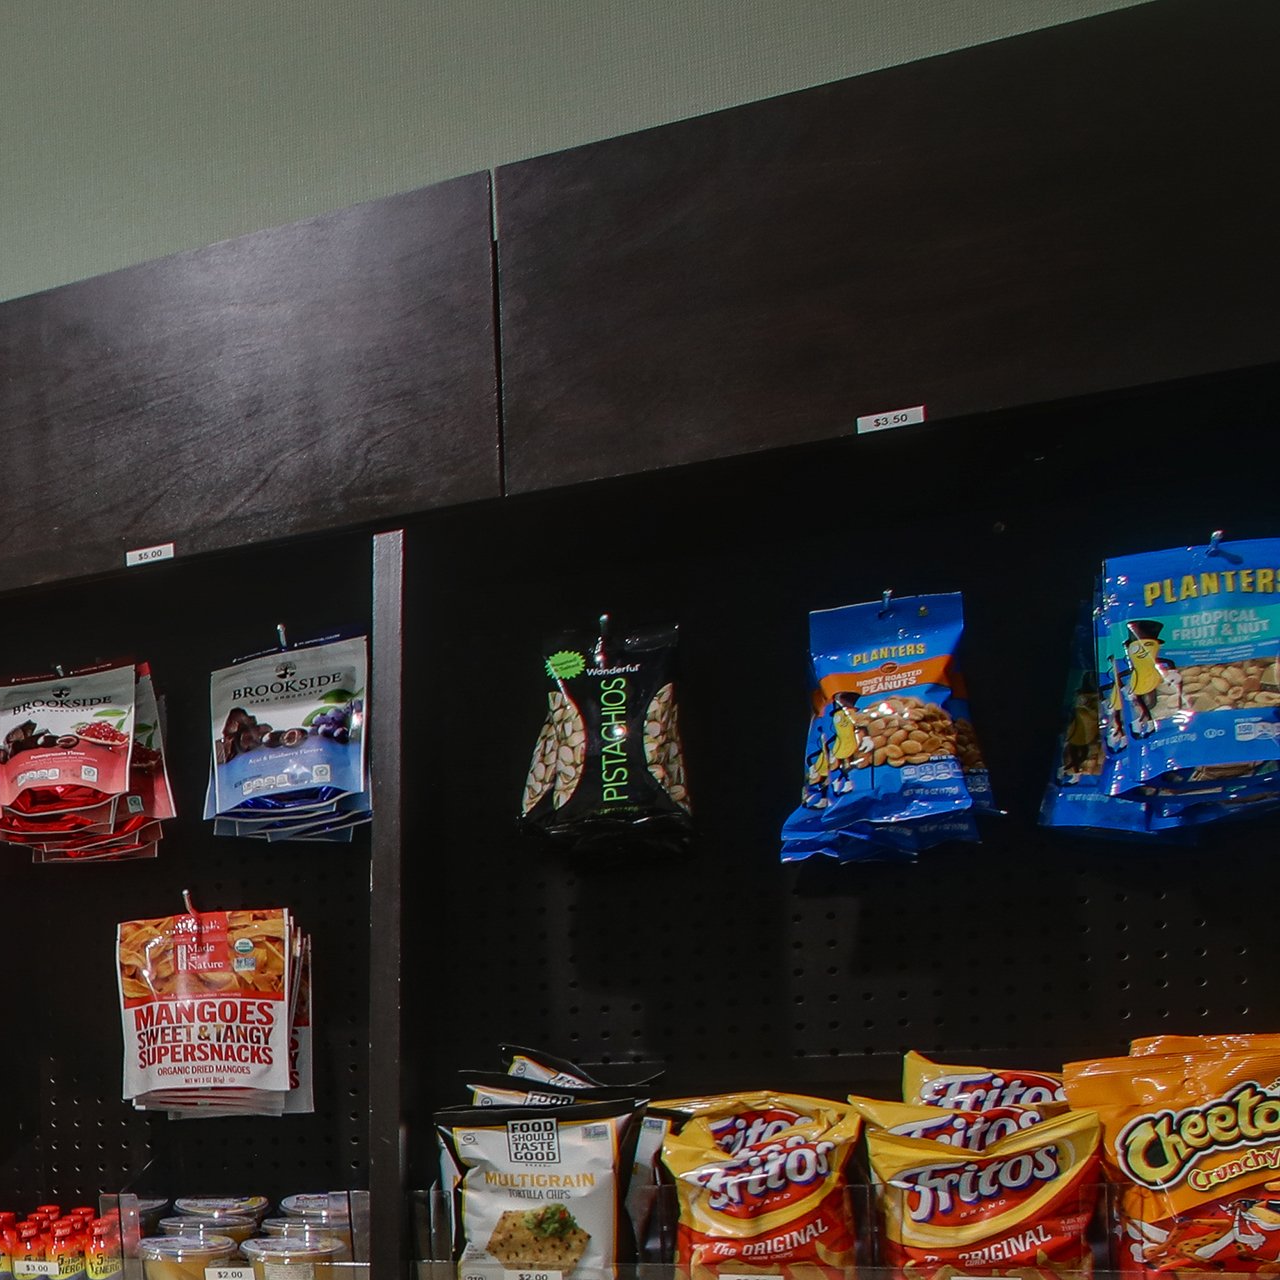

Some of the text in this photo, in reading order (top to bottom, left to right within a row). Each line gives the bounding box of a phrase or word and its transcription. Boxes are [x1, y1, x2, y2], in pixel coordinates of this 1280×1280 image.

[873, 412, 909, 429] $3.50
[137, 548, 163, 561] $5.00
[1180, 608, 1259, 628] TROPICAL
[1172, 618, 1270, 642] FRUIT & NUT
[1192, 636, 1225, 648] TRAIL
[851, 643, 927, 667] PLANTERS
[586, 663, 641, 677] Wonderful
[856, 669, 923, 687] HONEY ROASTED
[232, 671, 342, 701] BROOKSIDE
[861, 676, 917, 695] PEANUTS
[12, 694, 113, 716] BROOKSIDE
[600, 677, 629, 802] PISTACHIOS
[187, 943, 215, 954] Made
[188, 959, 224, 970] Nature
[134, 1000, 275, 1032] MANGOES
[137, 1024, 273, 1050] SWEET & TANGY
[138, 1043, 274, 1069] SUPERSNACKS
[157, 1065, 251, 1077] ORGANIC DRIED MANGOES
[510, 1121, 555, 1134] FOOD
[511, 1132, 556, 1142] SHOULD
[512, 1141, 556, 1152] TASTE
[513, 1151, 557, 1161] GOOD
[679, 1138, 838, 1213] Fritos
[1188, 1148, 1280, 1192] Crunchy
[484, 1172, 596, 1188] MULTIGRAIN
[889, 1143, 1060, 1222] Fritos
[508, 1188, 572, 1200] TORTILLA CHIPS
[959, 1198, 1007, 1219] BRAND
[711, 1220, 830, 1257] The ORIGINAL
[217, 1270, 243, 1279] $2.00
